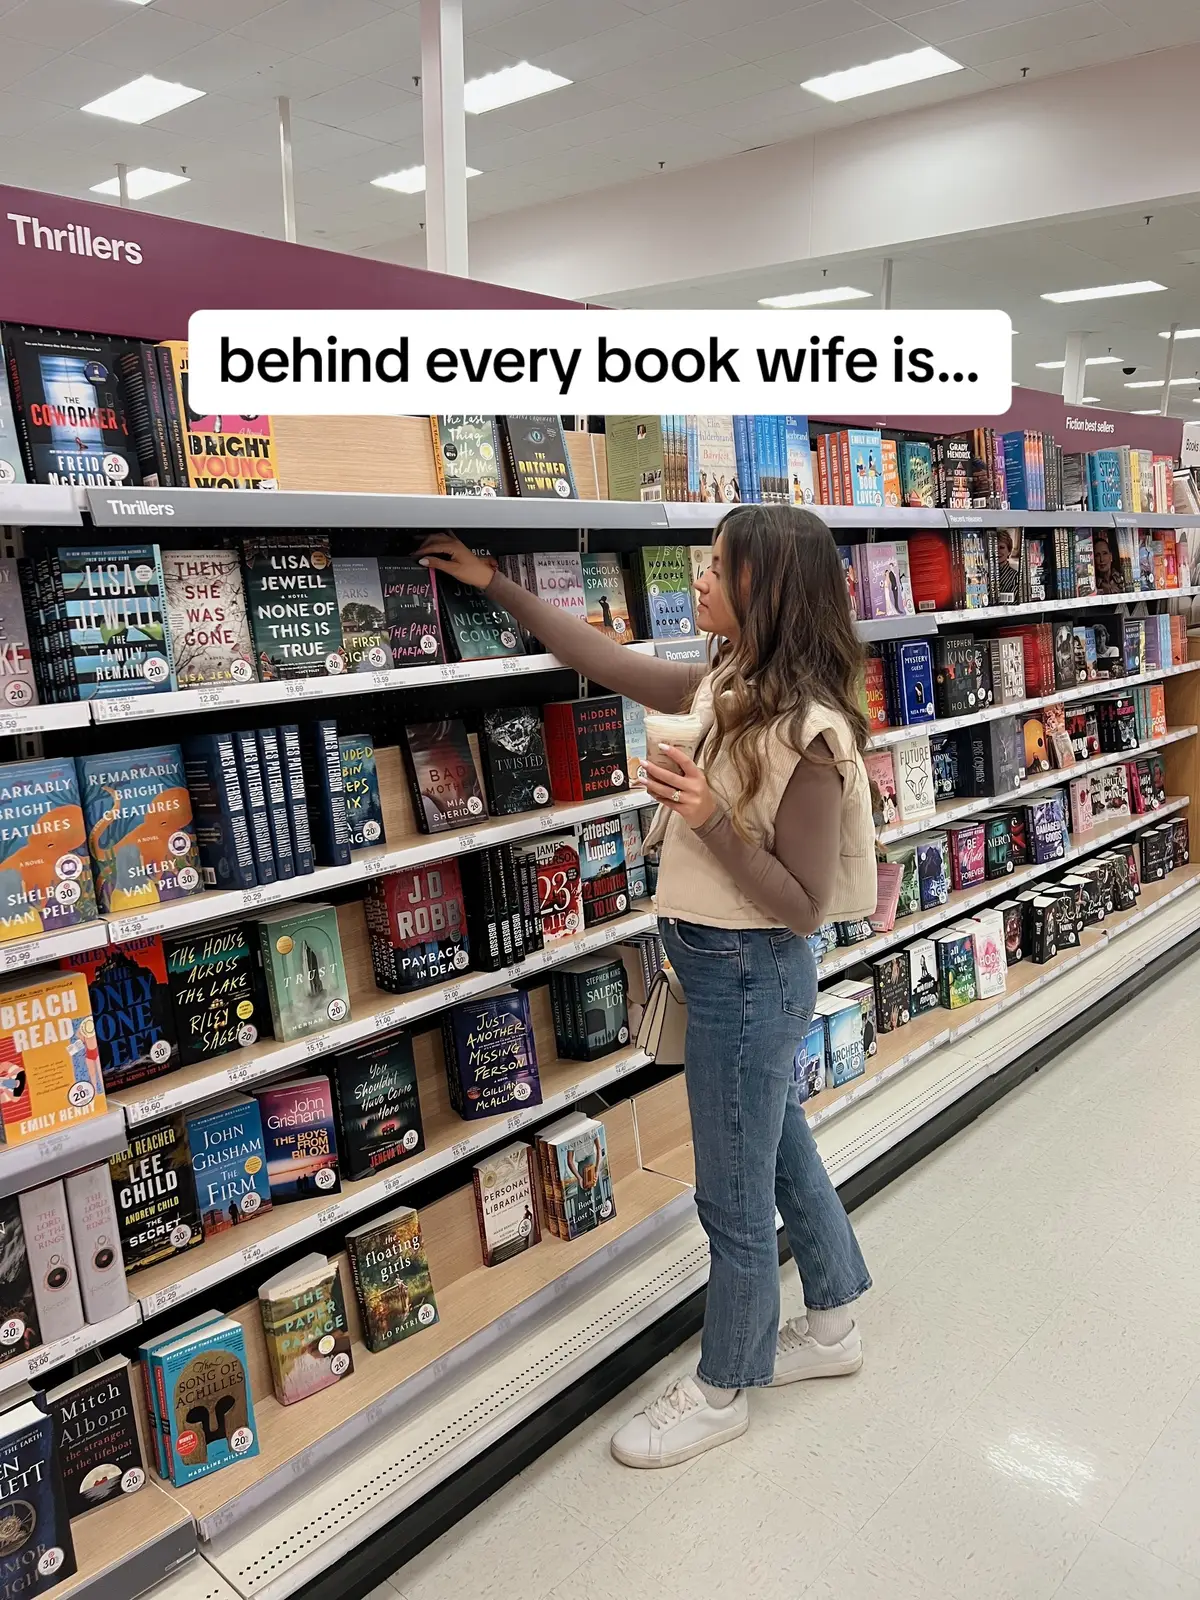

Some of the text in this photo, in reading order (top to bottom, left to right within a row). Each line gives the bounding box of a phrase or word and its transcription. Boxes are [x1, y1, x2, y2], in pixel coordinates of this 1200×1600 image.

[7, 213, 143, 265] Thrillers
[31, 403, 118, 430] COWORKER
[707, 419, 720, 428] Elin
[1066, 416, 1114, 434] Fiction best sellers
[188, 435, 270, 459] BRIGHT
[459, 445, 475, 456] He
[950, 442, 968, 451] GRADY
[1186, 438, 1199, 451] Books
[947, 450, 971, 460] HENDRIX
[190, 456, 274, 478] YOUNG
[858, 476, 877, 489] BOOK
[107, 499, 174, 516] Thrillers
[174, 562, 224, 577] THEN
[270, 555, 311, 570] LISA
[582, 566, 620, 576] NICHOLAS
[649, 560, 684, 568] NORMAL
[86, 564, 136, 597] LISA
[260, 575, 327, 591] JEWELL
[541, 577, 582, 590] LOCAL
[586, 577, 619, 589] SPARKS
[653, 572, 684, 580] PEOPLE
[185, 584, 221, 599] SHE
[384, 583, 430, 598] LUCY FOLEY
[75, 597, 157, 632] JEWELL
[186, 607, 225, 622] WAS
[258, 602, 335, 620] NONE OF
[659, 606, 685, 614] SALLY
[184, 630, 235, 646] GONE
[268, 622, 330, 639] THIS IS
[112, 635, 126, 645] THE
[352, 635, 381, 648] FIRST
[946, 639, 972, 649] STEPHEN
[99, 646, 143, 662] FAMILY
[279, 642, 325, 658] TRUE
[665, 649, 701, 661] Romance
[947, 650, 973, 664] KING
[904, 656, 927, 664] MYSTERY
[178, 672, 205, 683] LISA
[109, 703, 131, 713] 14.39
[580, 708, 617, 721] HIDDEN
[900, 746, 930, 766] FUTURE
[89, 762, 180, 787] REMARKABLY
[880, 778, 893, 787] Brain
[1103, 774, 1125, 787] BRUTAL
[115, 783, 164, 801] BRIGHT
[284, 731, 312, 854] JAMES PATTERSON CROSSHAIRS
[322, 726, 349, 845] JAMES PATTERSON CROSSHAIRS
[1104, 788, 1125, 797] PRINCE
[218, 741, 252, 868] JAMES PATTERSON CROSSHAIRS
[241, 738, 274, 863] JAMES PATTERSON CROSSHAIRS
[262, 735, 292, 858] JAMES PATTERSON CROSSHAIRS
[446, 798, 465, 808] MIA
[103, 798, 181, 822] CREATURES
[1036, 821, 1061, 836] DAMAGED
[1045, 829, 1062, 842] GOODS
[536, 841, 565, 860] JAMES
[585, 840, 616, 862] Lupica
[966, 837, 978, 850] BE
[987, 835, 1011, 850] MERCY
[127, 858, 177, 878] SHELBY
[961, 868, 985, 881] FOREVER
[123, 883, 153, 898] VAN
[537, 871, 571, 914] 23
[120, 923, 142, 935] 14.39
[397, 902, 460, 939] ROBB
[169, 945, 196, 968] THE
[202, 931, 246, 961] HOUSE
[402, 943, 461, 970] PAYBACK
[950, 944, 959, 954] all
[5, 951, 31, 965] 20.99
[954, 953, 968, 964] that
[187, 954, 240, 984] ACROSS
[283, 962, 338, 989] TRUST
[416, 969, 428, 979] IN
[585, 967, 622, 986] STEPHEN KING
[958, 964, 969, 972] we
[175, 972, 248, 1006] THE LAKE
[0, 990, 77, 1030] BEACH
[189, 1008, 230, 1035] RILEY
[476, 1012, 510, 1032] JUST
[13, 1017, 74, 1053] READ
[466, 1022, 526, 1048] ANOTHER
[468, 1044, 521, 1066] MISSING
[832, 1038, 865, 1063] ARCHER'S
[228, 1070, 247, 1081] 14.40
[369, 1063, 388, 1080] You
[474, 1058, 526, 1082] PERSON
[353, 1070, 399, 1100] Shouldn't
[140, 1102, 161, 1114] 19.60
[290, 1096, 325, 1114] John
[361, 1095, 385, 1112] Have
[20, 1113, 55, 1135] EMILY
[267, 1107, 326, 1130] Grisham
[135, 1128, 176, 1155] REACHER
[202, 1123, 245, 1150] JOHN
[273, 1128, 328, 1147] THE BOYS
[297, 1136, 329, 1150] FROM
[191, 1137, 262, 1171] GRISHAM
[291, 1145, 330, 1159] BILOXI
[130, 1153, 164, 1184] LEE
[220, 1169, 239, 1181] THE
[119, 1170, 178, 1209] CHILD
[207, 1176, 257, 1207] FIRM
[484, 1176, 529, 1204] PERSONAL
[485, 1187, 530, 1216] LIBRARIAN
[125, 1195, 180, 1226] ANDREW CHILD
[318, 1211, 335, 1222] 14.40
[146, 1216, 163, 1228] THE
[243, 1248, 261, 1261] 14.40
[364, 1234, 420, 1268] floating
[380, 1256, 412, 1281] girls
[156, 1291, 177, 1304] 20.29
[292, 1287, 324, 1310] THE
[284, 1300, 336, 1333] PAPER
[28, 1355, 49, 1371] 63.00
[179, 1360, 240, 1393] SONG OF
[176, 1371, 245, 1410] ACHILLES
[61, 1384, 121, 1424] Mitch
[59, 1404, 129, 1449] Albom
[65, 1452, 81, 1464] the
[84, 1428, 126, 1455] stranger
[94, 1438, 133, 1462] lifeboat
